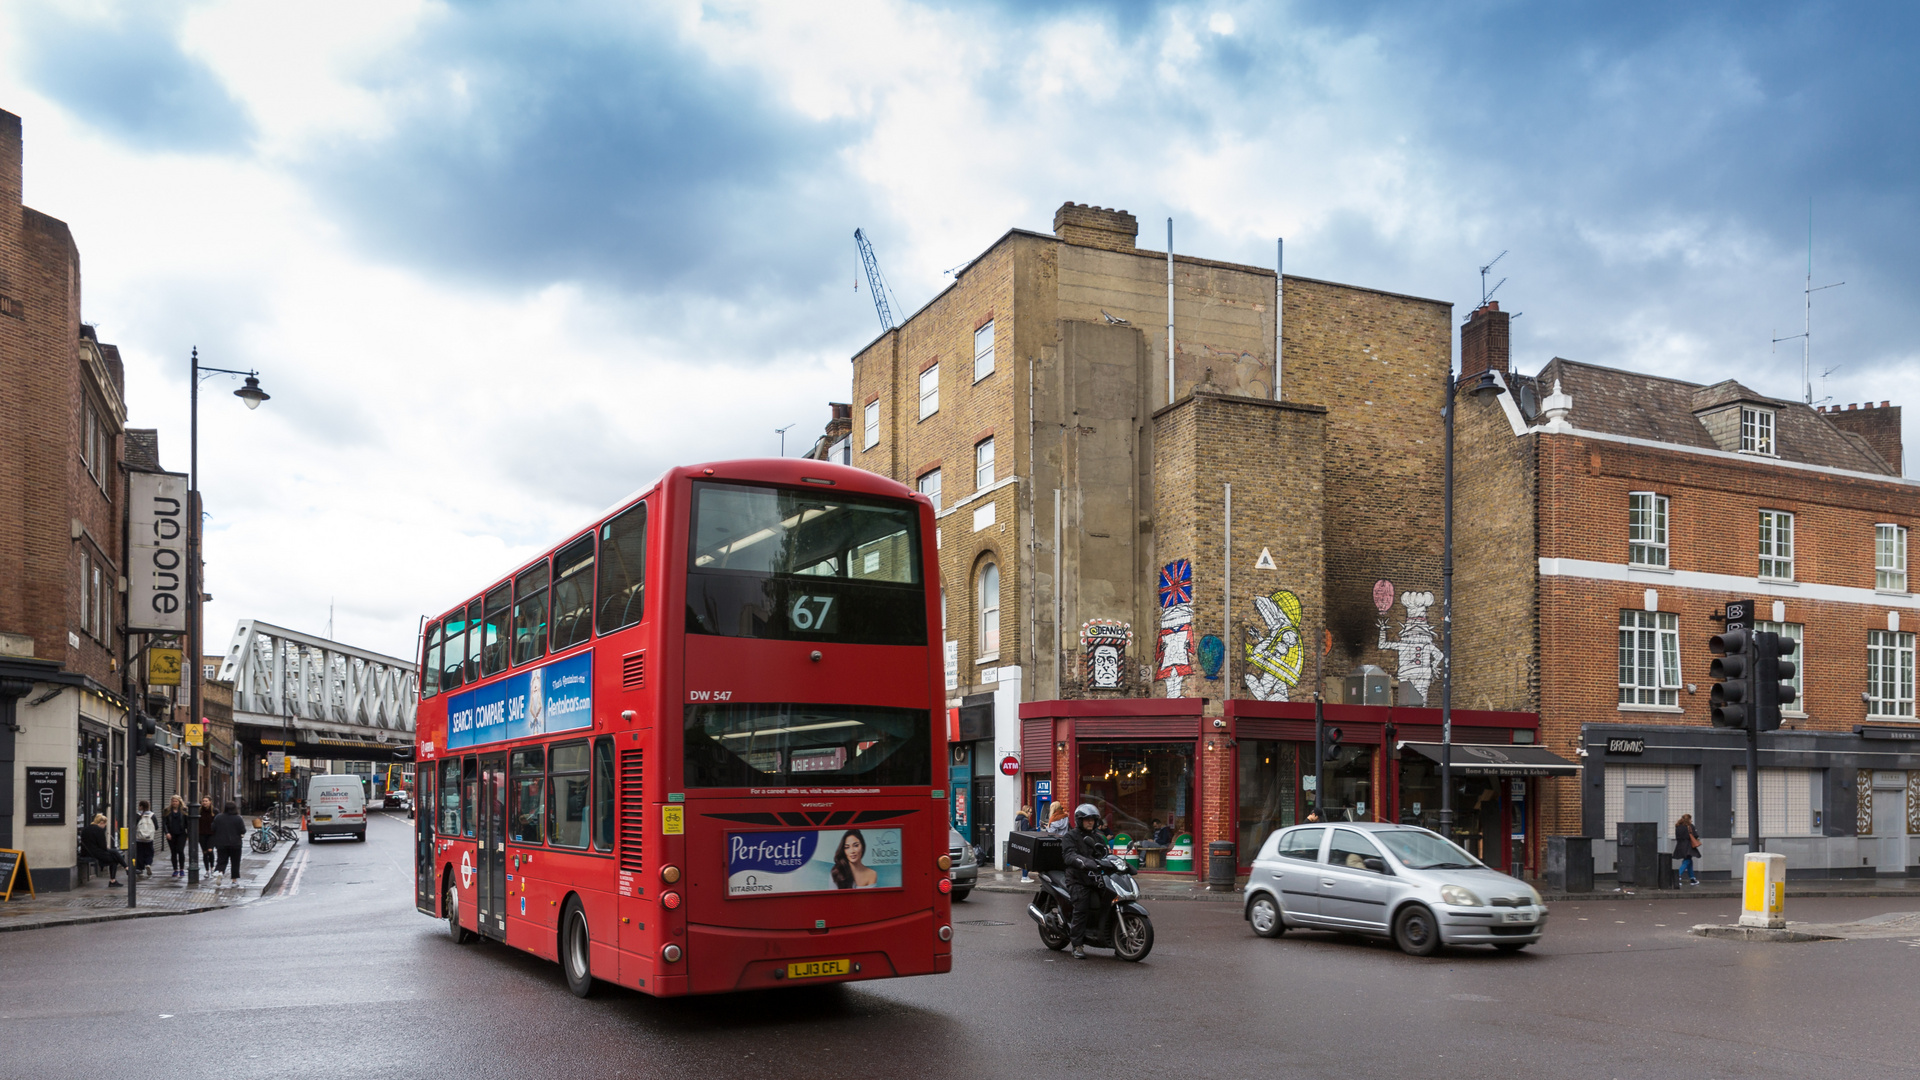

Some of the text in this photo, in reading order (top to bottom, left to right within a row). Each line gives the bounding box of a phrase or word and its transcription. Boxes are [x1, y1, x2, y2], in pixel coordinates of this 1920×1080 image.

[153, 497, 180, 614] no.one
[792, 596, 834, 629] 67
[690, 691, 732, 700] DW 547
[452, 695, 524, 733] SEARCH COMPARE SAVE
[548, 694, 590, 716] Rentalcars.com
[1610, 740, 1644, 752] BROWNS
[730, 836, 806, 864] Perfectil
[872, 848, 899, 857] Nicole
[1011, 843, 1031, 853] DELIVEROO
[795, 961, 843, 976] LJ13 CFL
